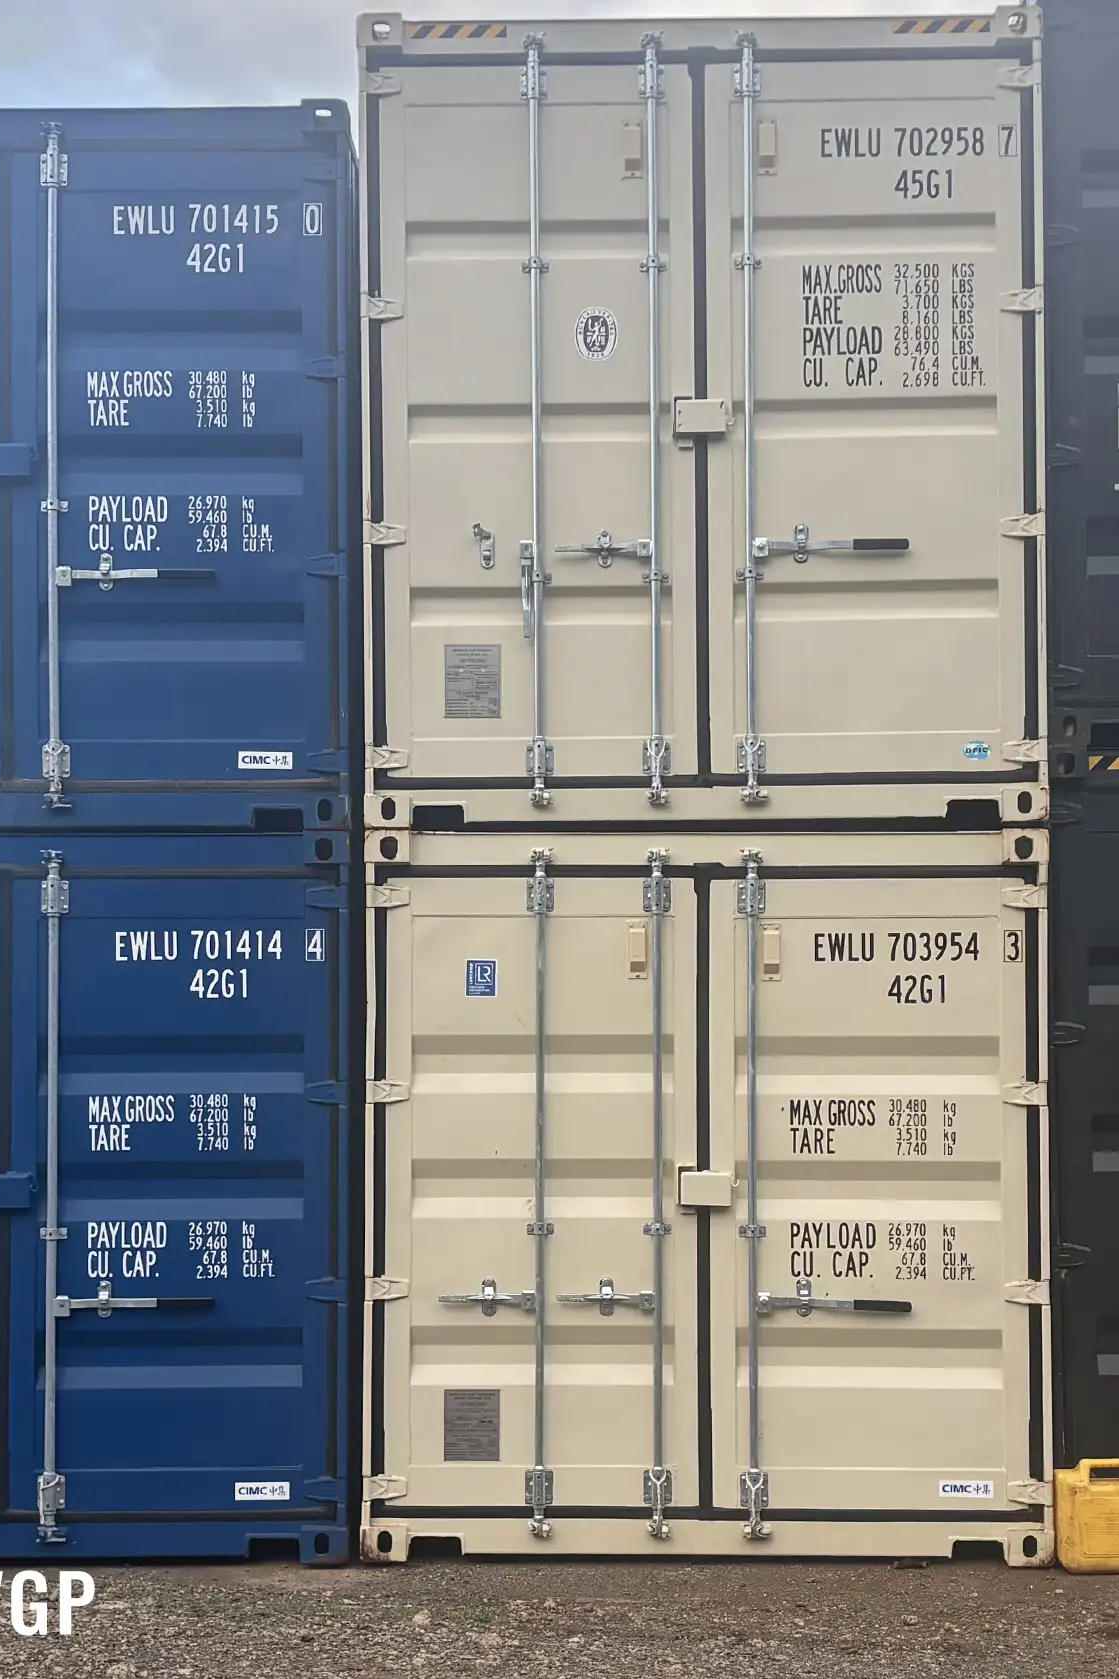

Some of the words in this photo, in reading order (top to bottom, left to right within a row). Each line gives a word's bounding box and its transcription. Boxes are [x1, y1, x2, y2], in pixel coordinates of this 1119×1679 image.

[820, 128, 882, 158] EWLU
[894, 126, 985, 158] 702958
[1000, 126, 1014, 156] 7
[894, 169, 954, 200] 45G1
[112, 205, 176, 235] EWLU
[188, 204, 280, 234] 701415
[304, 204, 320, 234] 0
[186, 243, 245, 274] 42G1
[802, 264, 882, 294] MAX.GROSS
[894, 263, 940, 280] 32.500
[951, 263, 975, 280] KGS
[894, 278, 940, 294] 71.650
[951, 278, 974, 294] LBS
[802, 295, 844, 326] TARE
[902, 294, 940, 310] 3.700
[951, 294, 975, 310] KGS
[902, 310, 940, 326] 8.160
[951, 310, 974, 326] LBS
[802, 326, 883, 356] PAYLOAD
[894, 325, 940, 341] 28.800
[951, 325, 975, 341] KGS
[894, 340, 940, 356] 63.490
[951, 340, 974, 356] LBS
[804, 356, 829, 388] CU.
[844, 356, 884, 387] CAP.
[910, 356, 940, 372] 76.4
[951, 356, 983, 372] CU.M.
[86, 370, 120, 398] MAX
[123, 370, 174, 398] GROSS
[188, 370, 228, 385] 30.480
[242, 370, 256, 386] kg
[902, 371, 940, 388] 2.698
[951, 371, 987, 388] CU.FT.
[188, 384, 228, 399] 67.200
[242, 384, 253, 399] lb
[88, 400, 130, 426] TARE
[196, 399, 228, 414] 3.510
[242, 400, 256, 416] kg
[196, 414, 228, 428] 7.740
[242, 414, 253, 428] lb
[88, 495, 168, 522] PAYLOAD
[188, 495, 227, 510] 26.970
[242, 496, 255, 512] kg
[188, 510, 228, 524] 59.460
[242, 510, 253, 524] lb
[88, 524, 114, 551] CU.
[123, 524, 161, 552] CAP.
[202, 524, 228, 538] 67.8
[242, 524, 274, 538] CU.M.
[196, 538, 228, 553] 2.394
[242, 538, 276, 552] CU.FT.
[242, 755, 271, 765] CIMC
[114, 930, 178, 962] EWLU
[190, 930, 282, 960] 701414
[308, 930, 322, 960] 4
[814, 932, 875, 962] EWLU
[887, 932, 980, 962] 703954
[1006, 932, 1020, 961] 3
[190, 968, 248, 1000] 42G1
[888, 974, 946, 1004] 42G1
[88, 1095, 122, 1123] MAX
[125, 1094, 175, 1122] GROSS
[189, 1094, 229, 1108] 30.480
[243, 1094, 257, 1111] kg
[888, 1098, 927, 1114] 30.480
[943, 1100, 957, 1116] kg
[189, 1108, 229, 1122] 67.200
[243, 1108, 254, 1122] lb
[789, 1098, 823, 1126] MAX
[828, 1099, 876, 1127] GROSS
[888, 1113, 927, 1128] 67.200
[944, 1114, 954, 1128] lb
[88, 1124, 131, 1152] TARE
[196, 1122, 229, 1137] 3.510
[243, 1122, 257, 1140] kg
[896, 1128, 927, 1142] 3.510
[943, 1128, 957, 1146] kg
[196, 1136, 229, 1151] 7.740
[243, 1136, 254, 1151] lb
[790, 1128, 836, 1154] TARE
[896, 1142, 927, 1156] 7.740
[944, 1142, 954, 1156] lb
[87, 1221, 168, 1249] PAYLOAD
[188, 1220, 228, 1236] 26.970
[242, 1220, 256, 1238] kg
[790, 1222, 876, 1250] PAYLOAD
[888, 1222, 926, 1237] 26.970
[942, 1224, 956, 1240] kg
[188, 1235, 228, 1250] 59.460
[242, 1235, 253, 1250] lb
[888, 1237, 926, 1252] 59.460
[942, 1238, 953, 1252] lb
[87, 1250, 114, 1278] CU.
[122, 1250, 160, 1278] CAP.
[202, 1250, 228, 1265] 67.8
[242, 1249, 274, 1264] CU.M.
[790, 1250, 821, 1278] CU.
[832, 1251, 874, 1278] CAP.
[901, 1252, 926, 1266] 67.8
[942, 1252, 972, 1267] CU.M.
[196, 1264, 228, 1280] 2.394
[242, 1264, 276, 1278] CU.FT.
[895, 1266, 927, 1280] 2.394
[238, 1486, 268, 1496] CIMC
[942, 1484, 972, 1494] CIMC
